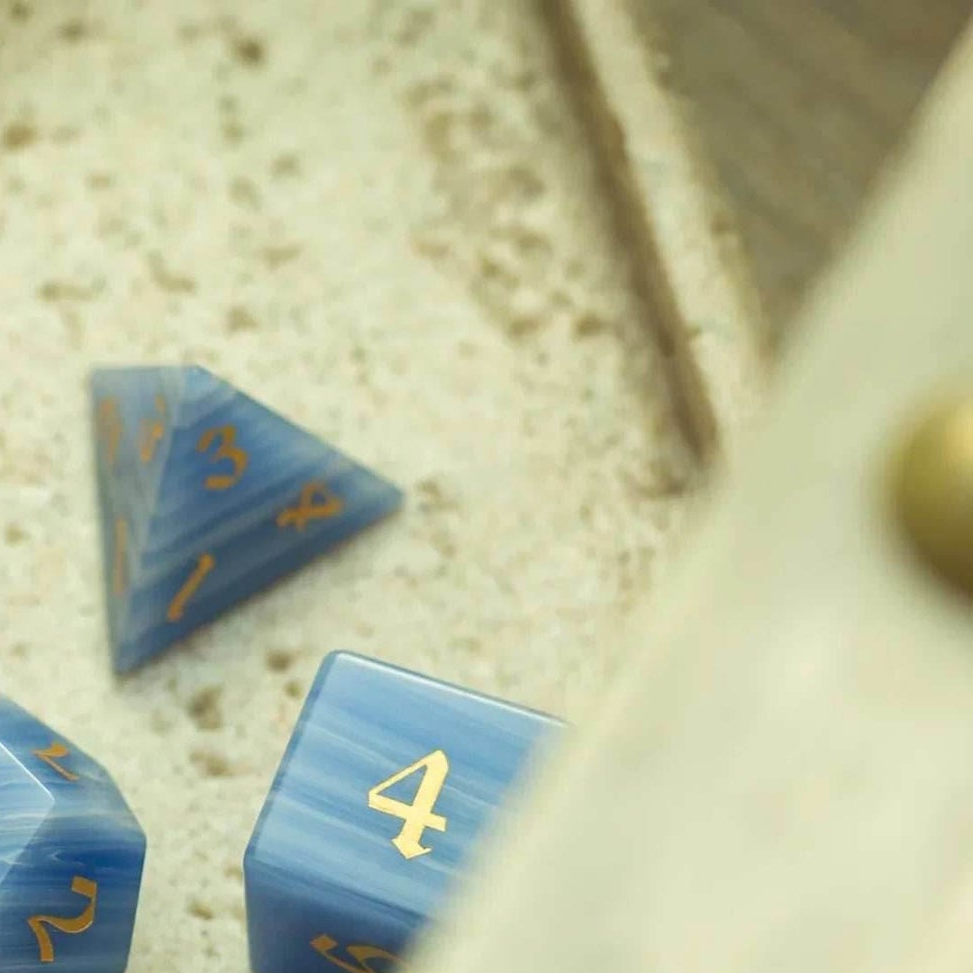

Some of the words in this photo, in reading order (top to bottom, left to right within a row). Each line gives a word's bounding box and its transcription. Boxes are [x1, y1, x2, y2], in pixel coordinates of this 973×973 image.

[196, 424, 249, 490] 3
[275, 482, 345, 532] 4
[167, 552, 215, 622] 1
[368, 749, 450, 861] 4
[27, 875, 98, 963] 2
